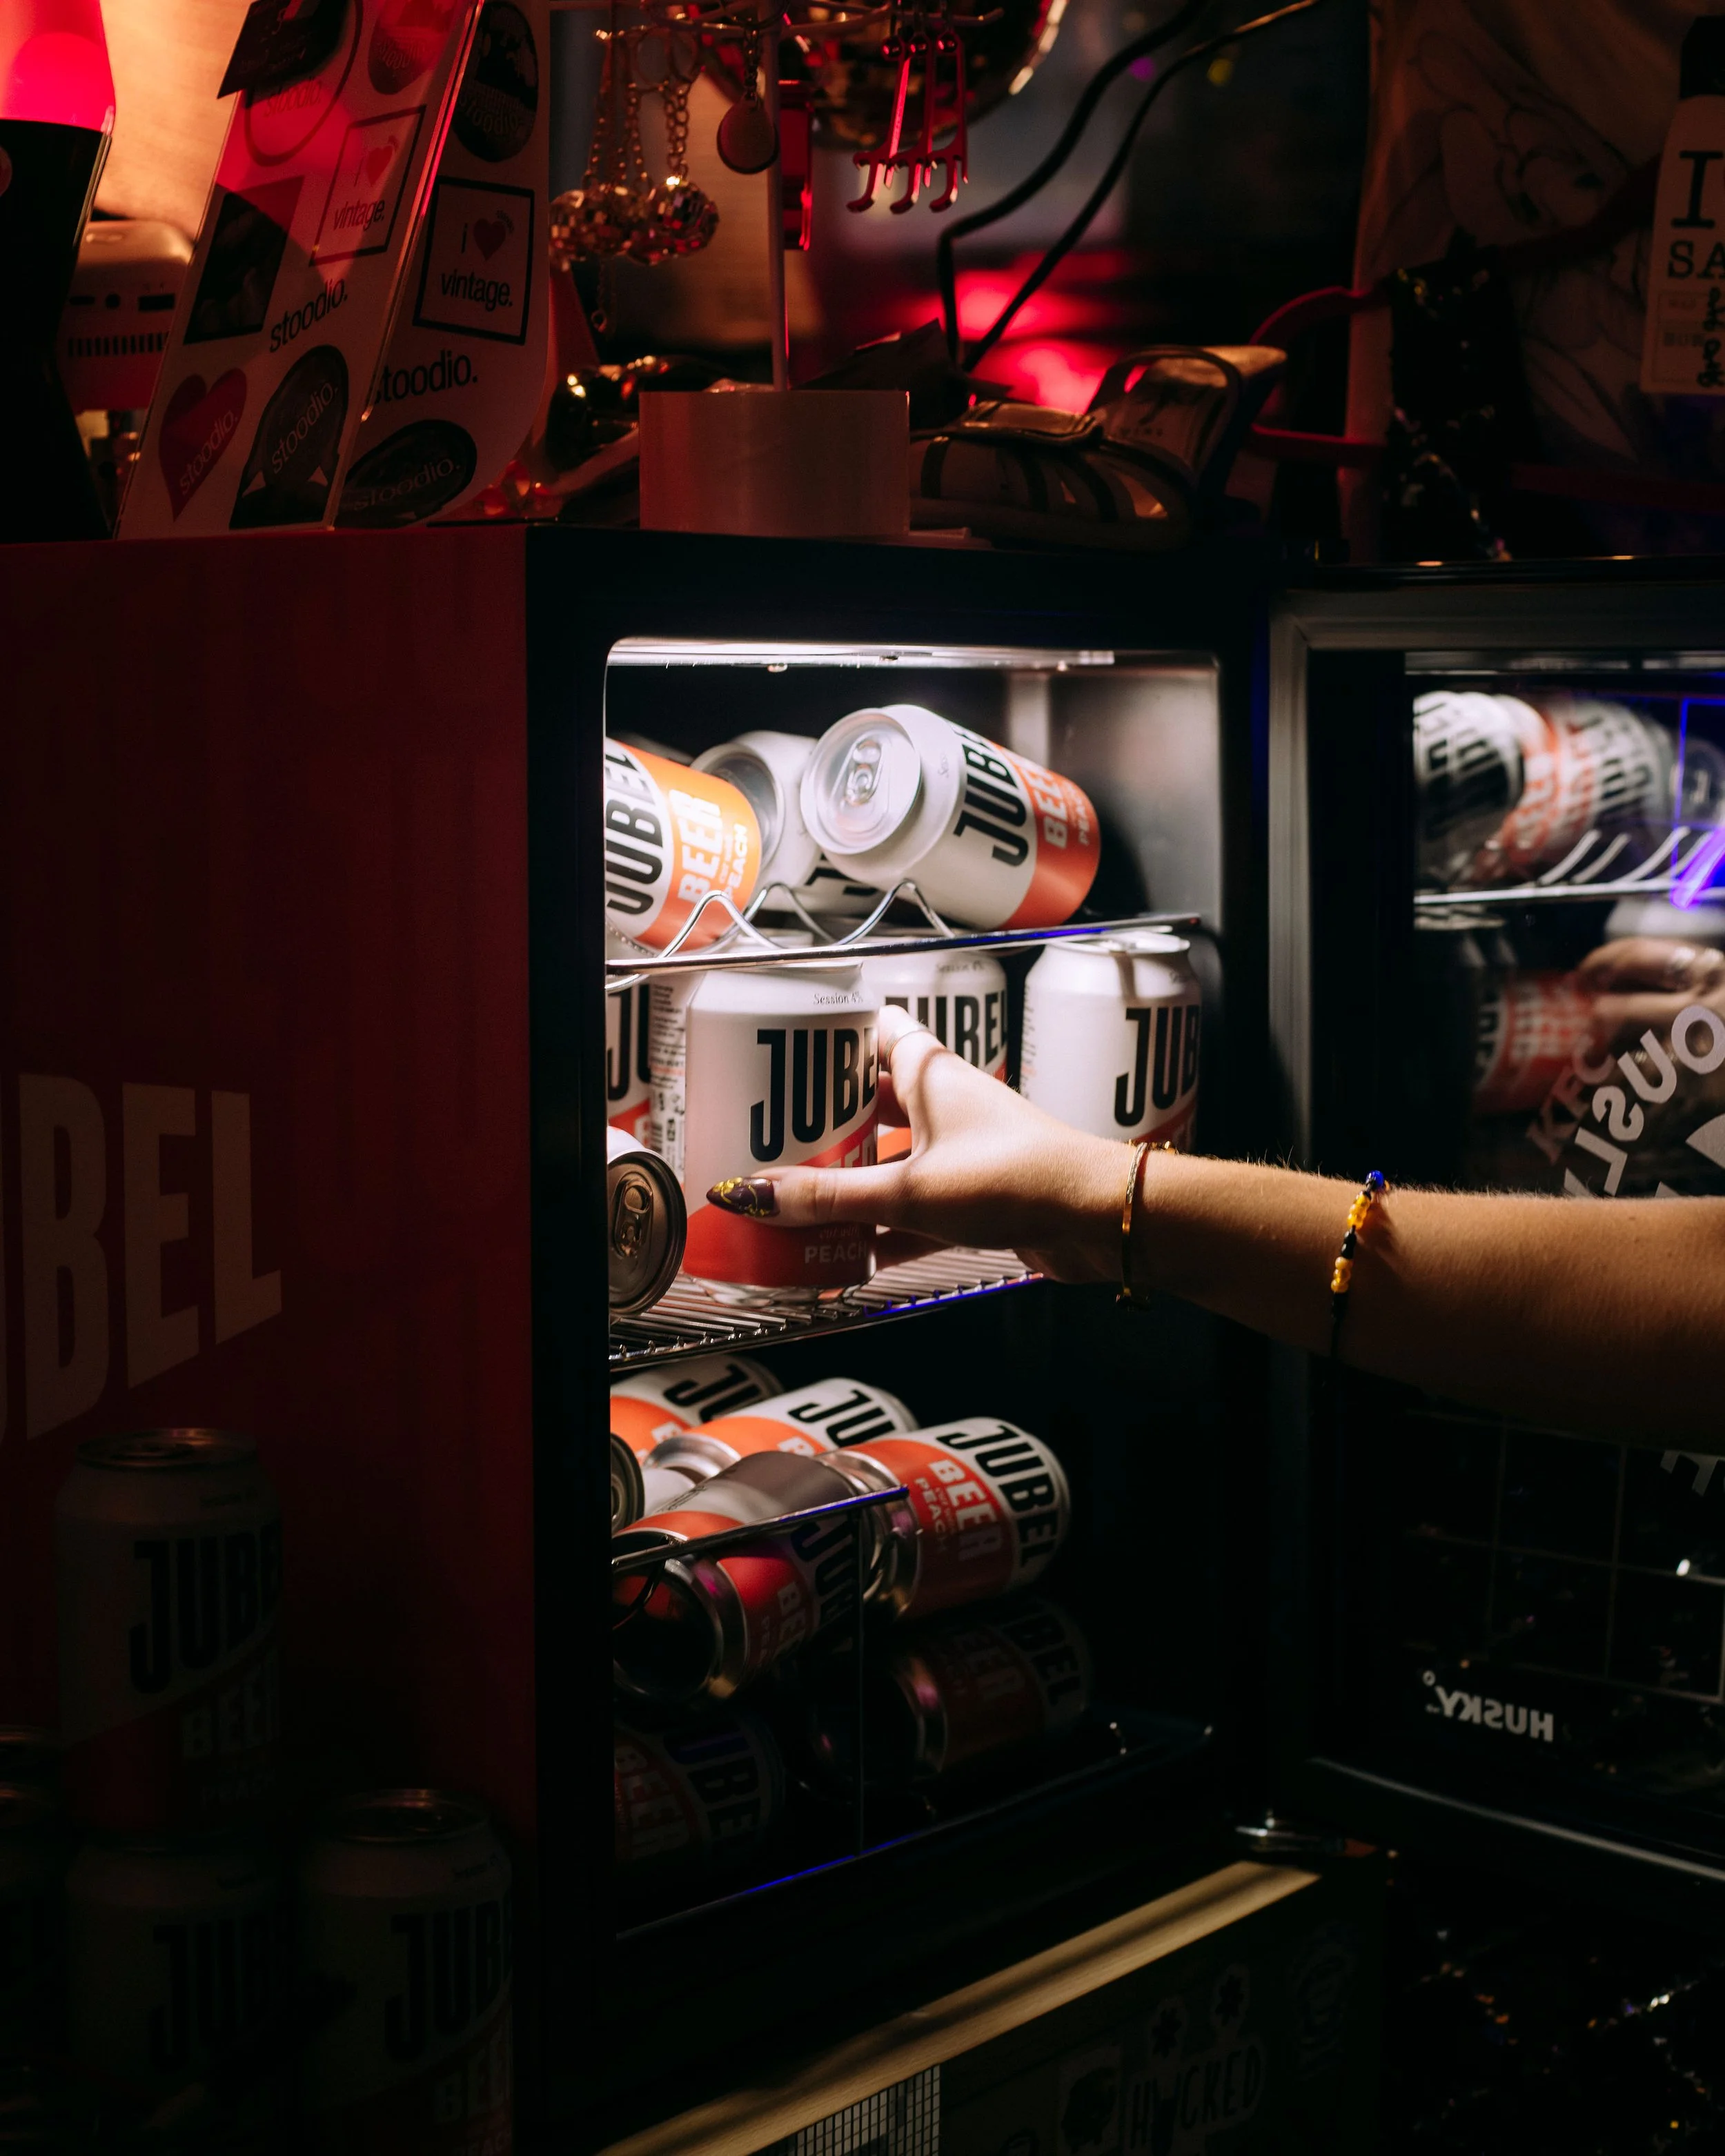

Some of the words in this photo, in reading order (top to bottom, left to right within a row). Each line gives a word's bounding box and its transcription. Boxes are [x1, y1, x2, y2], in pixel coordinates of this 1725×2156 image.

[334, 198, 385, 232] vintage.
[1670, 150, 1724, 228] I
[270, 279, 348, 353] stoodio.
[440, 268, 514, 313] vintage.
[179, 409, 239, 495] stoodio.
[271, 380, 339, 474] stoodio.
[353, 457, 462, 511] stoodio.
[951, 726, 1029, 868] JUB
[813, 993, 849, 1005] Session
[749, 1028, 879, 1163] JUBE
[0, 1072, 282, 1442] BEL
[927, 1459, 1003, 1561] BEER
[936, 1425, 1058, 1568] JUBEL
